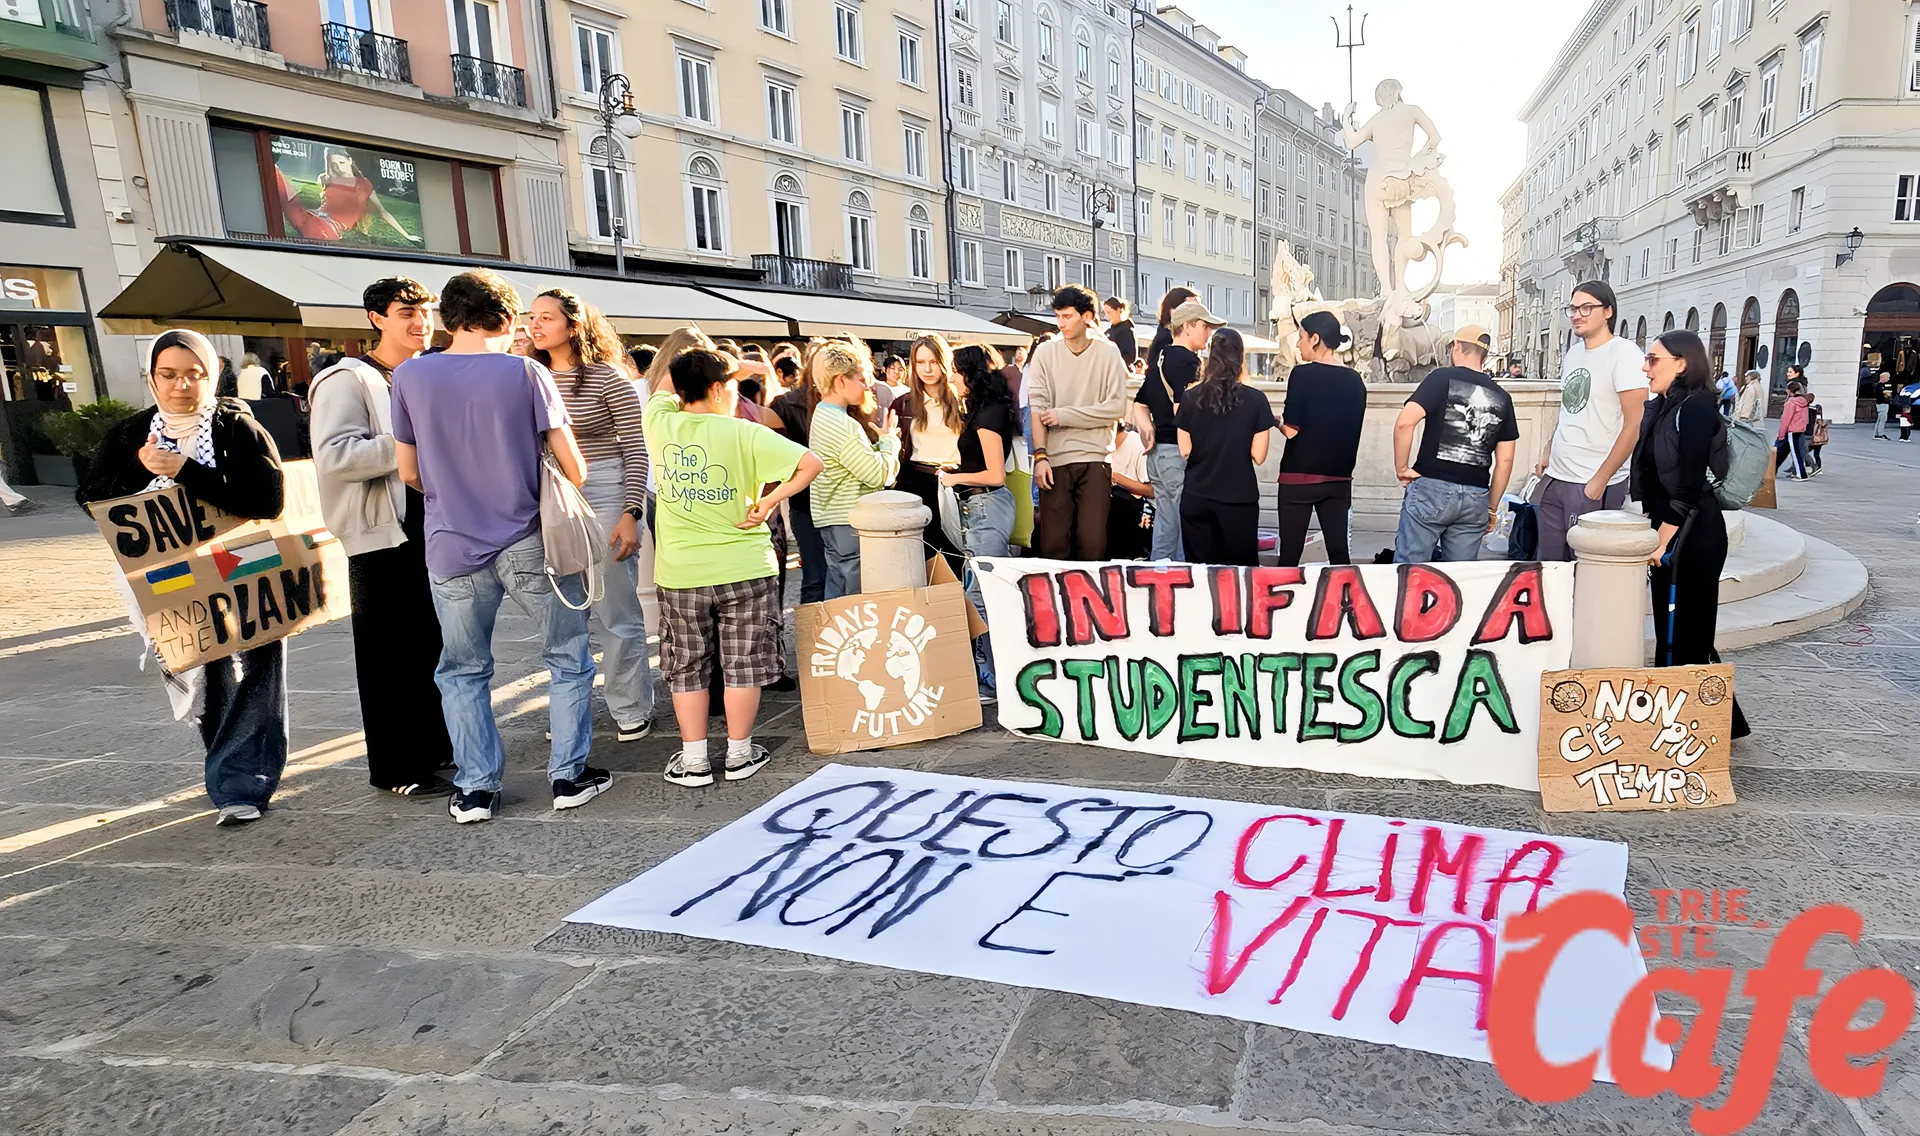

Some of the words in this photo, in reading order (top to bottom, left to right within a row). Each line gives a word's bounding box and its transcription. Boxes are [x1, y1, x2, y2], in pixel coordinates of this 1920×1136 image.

[380, 159, 401, 171] BORN
[402, 162, 414, 173] TO
[381, 168, 414, 182] DISOBEY
[663, 469, 708, 484] More
[673, 450, 698, 467] The
[671, 484, 737, 501] Messier
[108, 488, 216, 558] SAVE
[160, 600, 208, 636] AND
[207, 561, 327, 645] PLAN
[1017, 561, 1553, 647] INTIFADA
[162, 625, 213, 658] THE
[811, 602, 880, 678] FRIDAYS
[891, 605, 937, 654] FOR
[852, 681, 945, 738] FUTURE
[1015, 649, 1521, 744] STUDENTESCA
[1592, 679, 1690, 728] NON
[1573, 759, 1708, 807] TEMPO
[763, 779, 1214, 869] QUESTO
[670, 829, 972, 939] NON
[1206, 889, 1497, 1031] VITA
